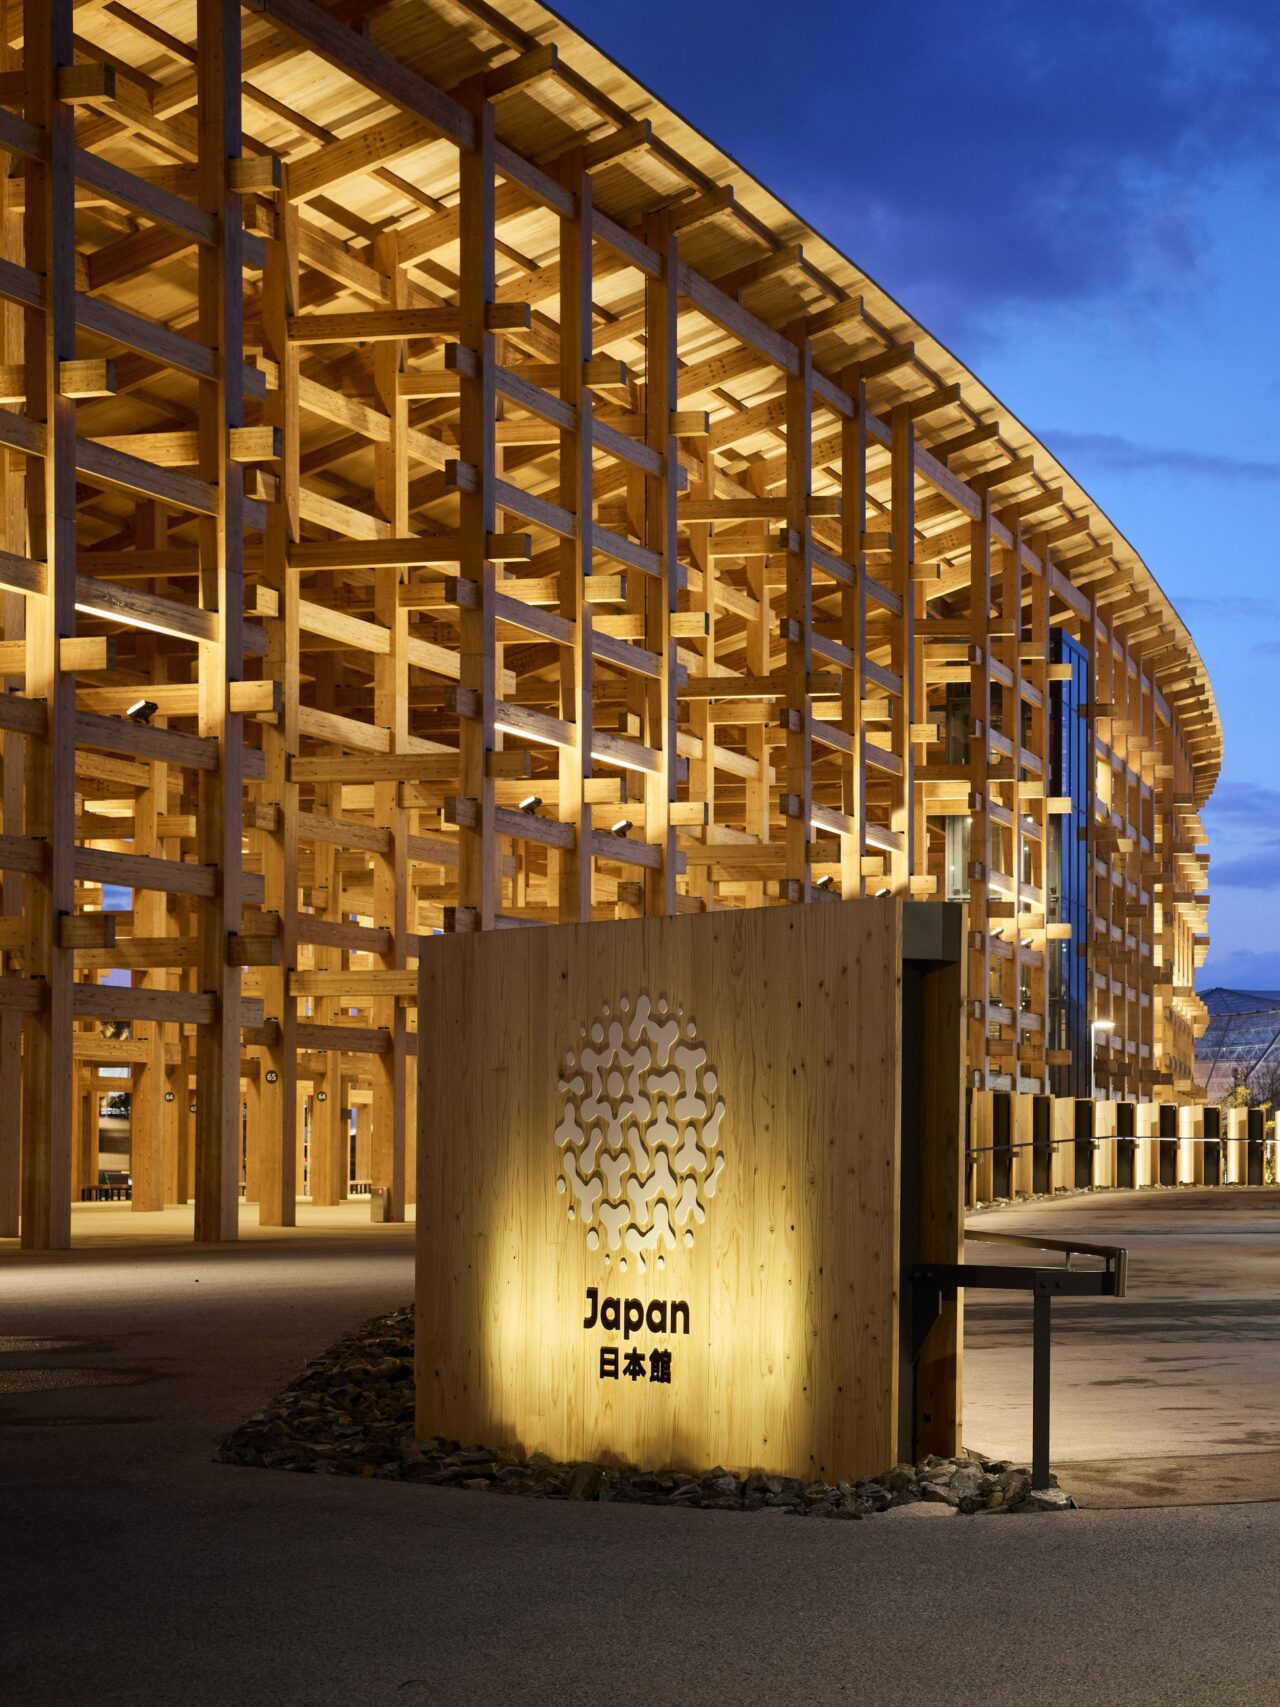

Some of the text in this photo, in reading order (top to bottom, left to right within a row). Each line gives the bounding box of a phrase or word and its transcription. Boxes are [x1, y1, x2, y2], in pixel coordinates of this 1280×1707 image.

[583, 1287, 690, 1340] Japan
[599, 1346, 672, 1384] 日本館
